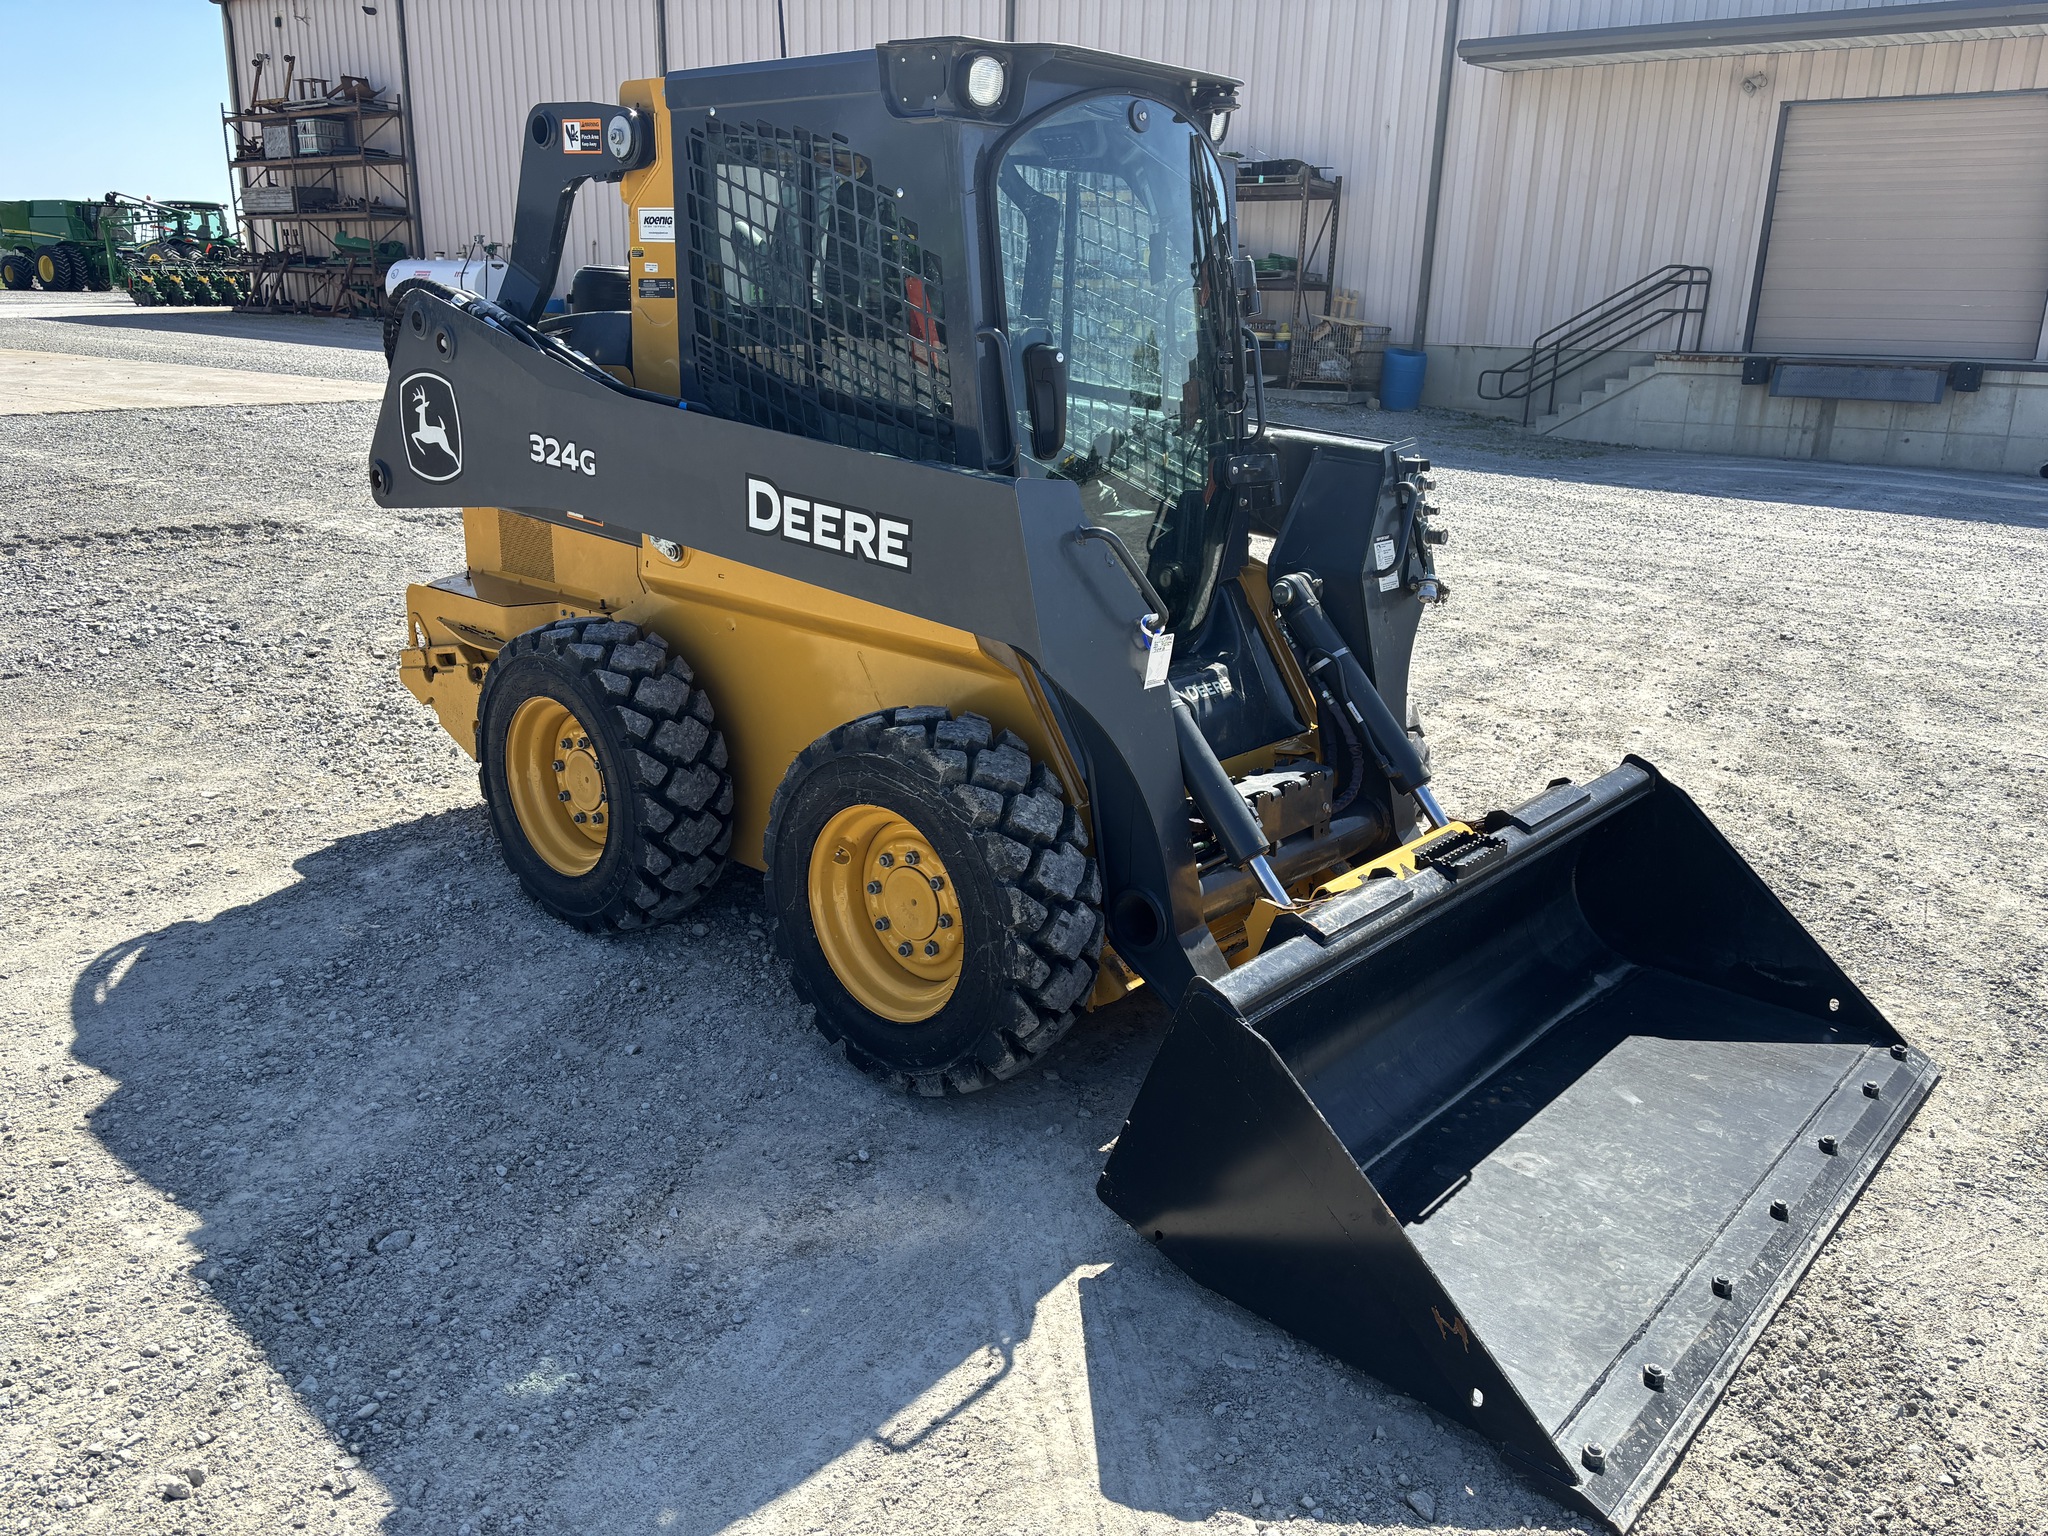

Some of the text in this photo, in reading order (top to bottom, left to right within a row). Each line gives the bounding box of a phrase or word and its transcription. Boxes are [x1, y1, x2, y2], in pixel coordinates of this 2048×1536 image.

[529, 433, 596, 476] 324G
[748, 478, 909, 568] DEERE
[1184, 677, 1232, 701] DEERE
